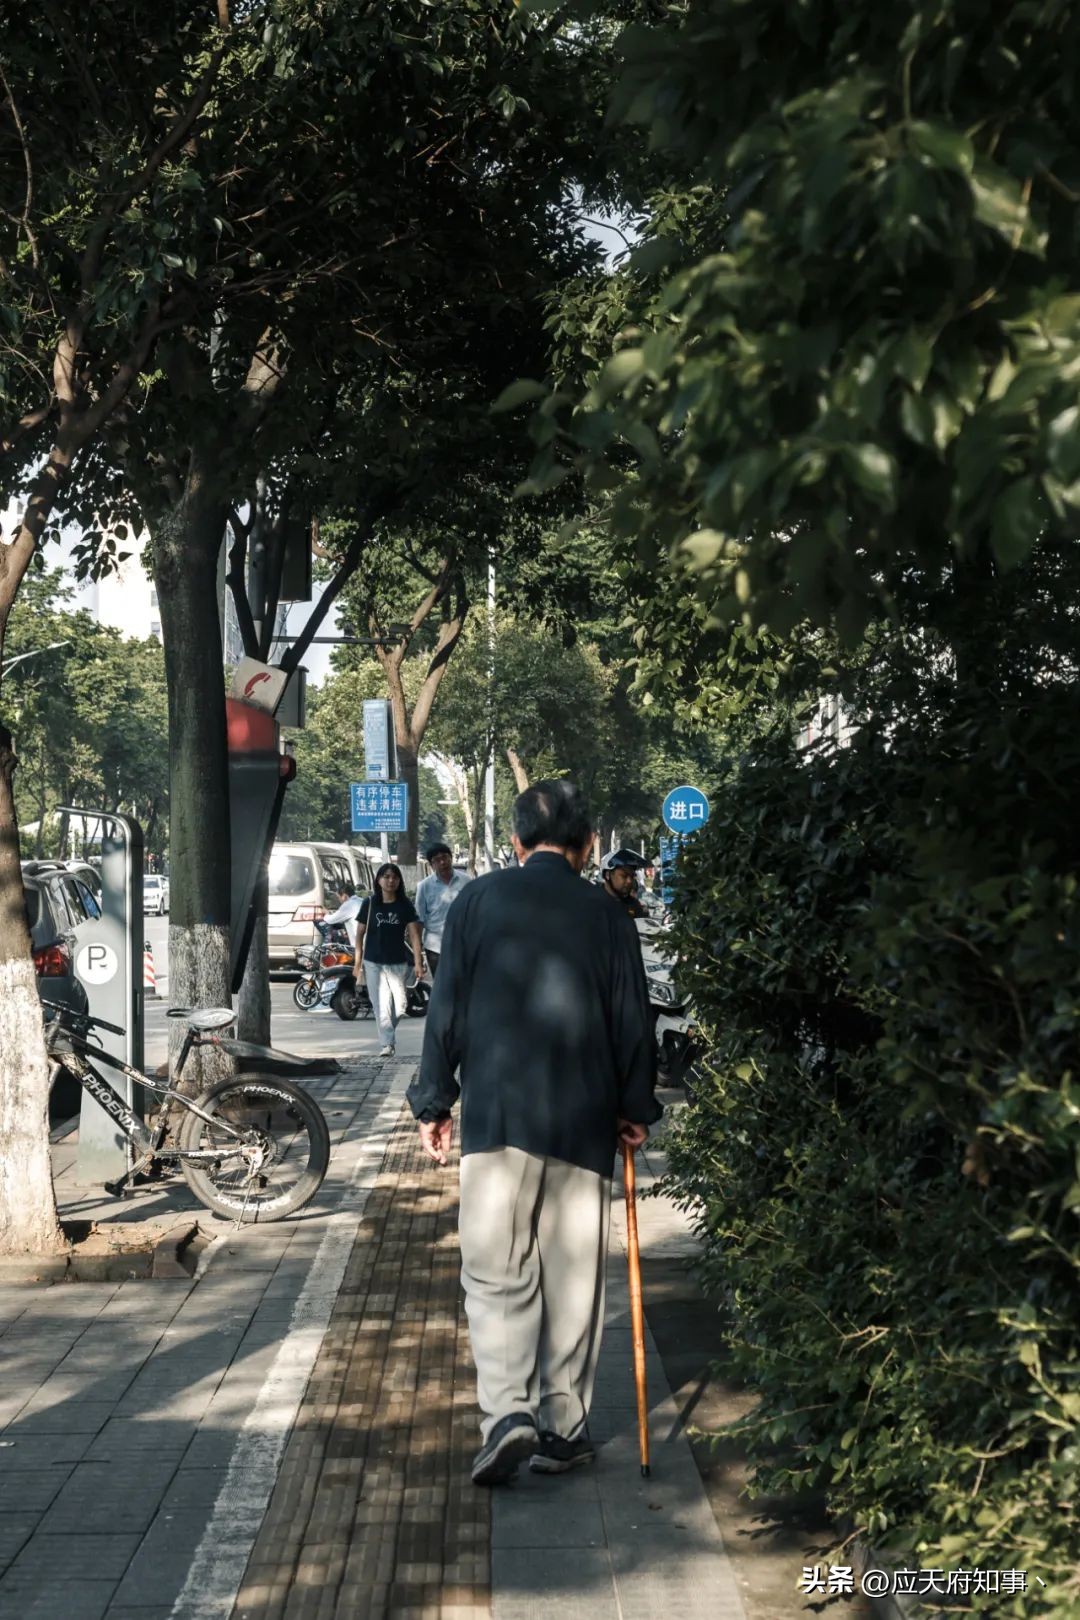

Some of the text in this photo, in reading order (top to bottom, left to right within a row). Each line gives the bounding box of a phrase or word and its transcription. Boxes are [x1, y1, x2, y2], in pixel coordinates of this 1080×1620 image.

[356, 786, 402, 798] 有序停车
[669, 801, 704, 820] 进口
[376, 912, 400, 927] Smile
[88, 946, 107, 970] P
[82, 1073, 140, 1135] PHOENIX
[243, 1085, 296, 1104] PHOENIX
